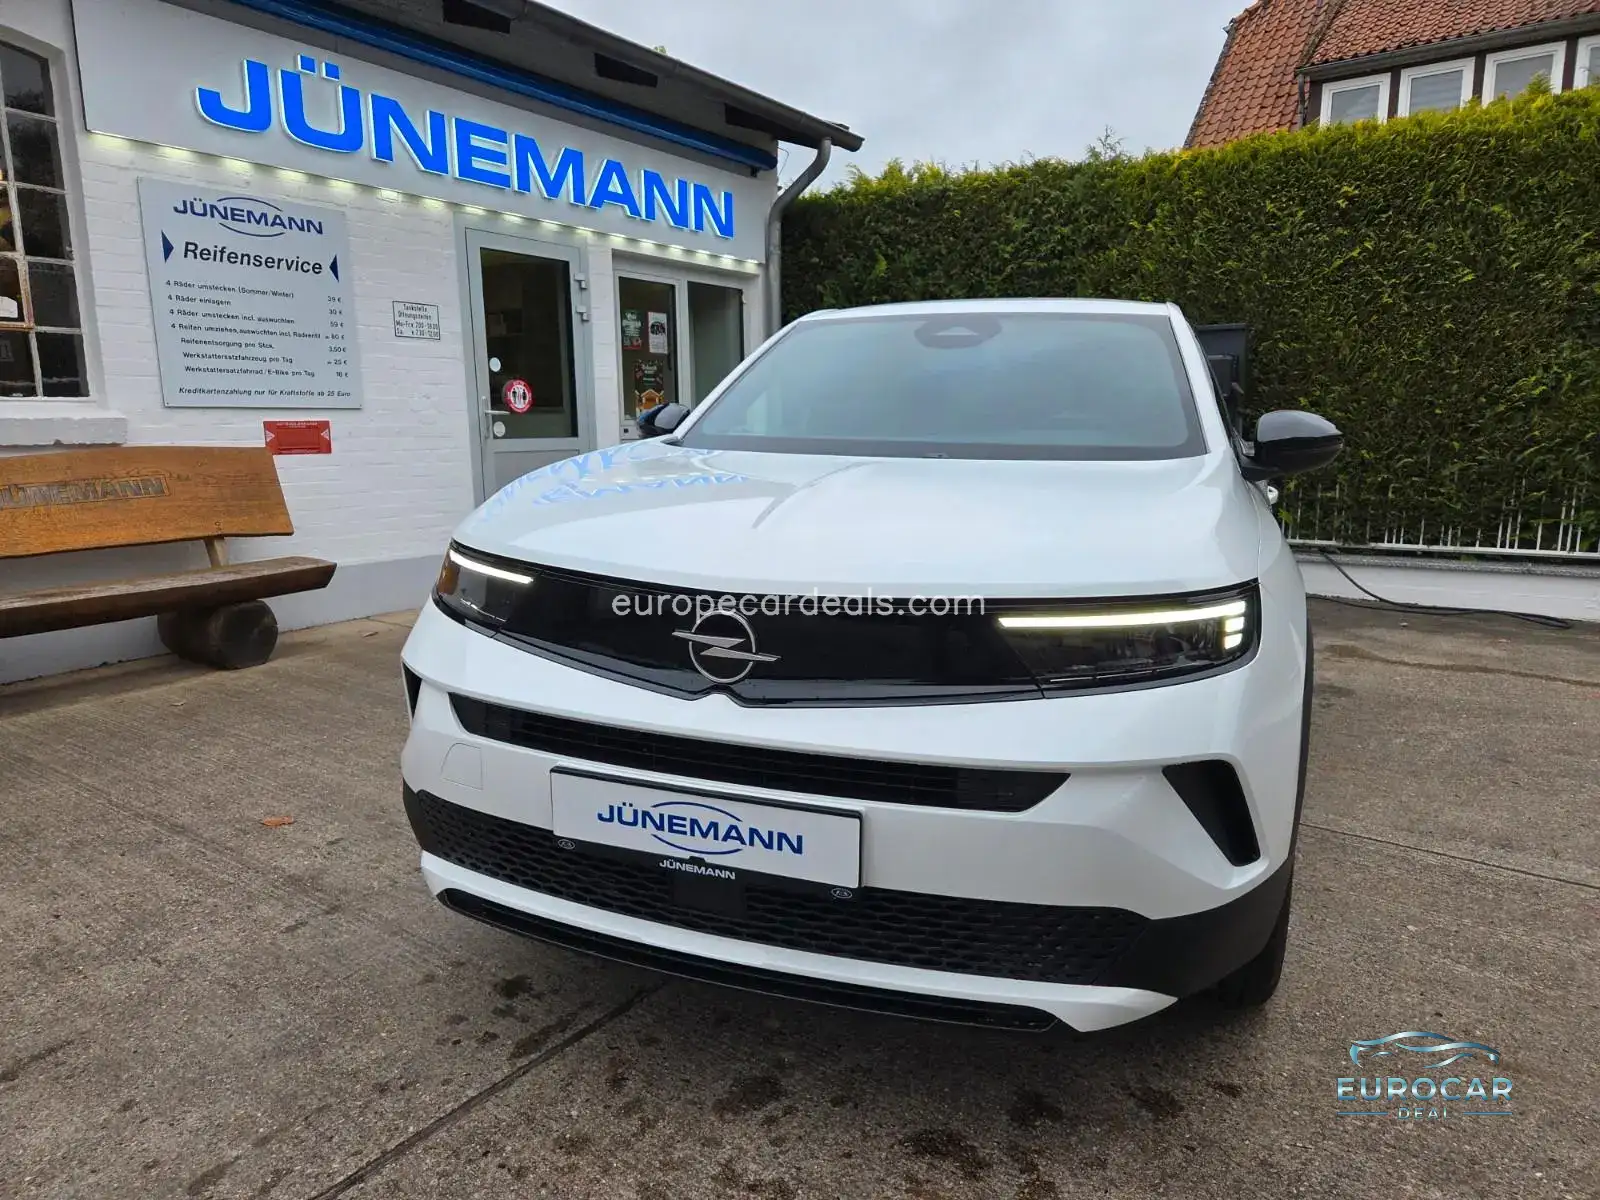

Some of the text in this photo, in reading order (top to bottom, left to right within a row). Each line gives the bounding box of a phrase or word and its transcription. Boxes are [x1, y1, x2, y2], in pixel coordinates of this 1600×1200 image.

[195, 55, 734, 239] JÜNEMANN
[173, 198, 323, 235] JÜNEMANN
[183, 241, 323, 274] Reifenservice
[173, 280, 195, 288] Räder
[197, 284, 236, 292] umstecken
[175, 294, 197, 302] Räder
[177, 309, 198, 317] Räder
[201, 312, 240, 320] umstecken
[178, 323, 202, 331] Reifen
[181, 338, 243, 348] Reifenentsorgung
[183, 351, 267, 363] Werkstattersatzfahrzeug
[282, 356, 293, 364] Tag
[304, 370, 315, 378] Tag
[179, 387, 252, 396] Kreditkartenzahlung
[279, 389, 315, 397] Kraftstoffe
[597, 802, 804, 855] JÜNEMANN
[659, 859, 736, 880] JÜNEMANN
